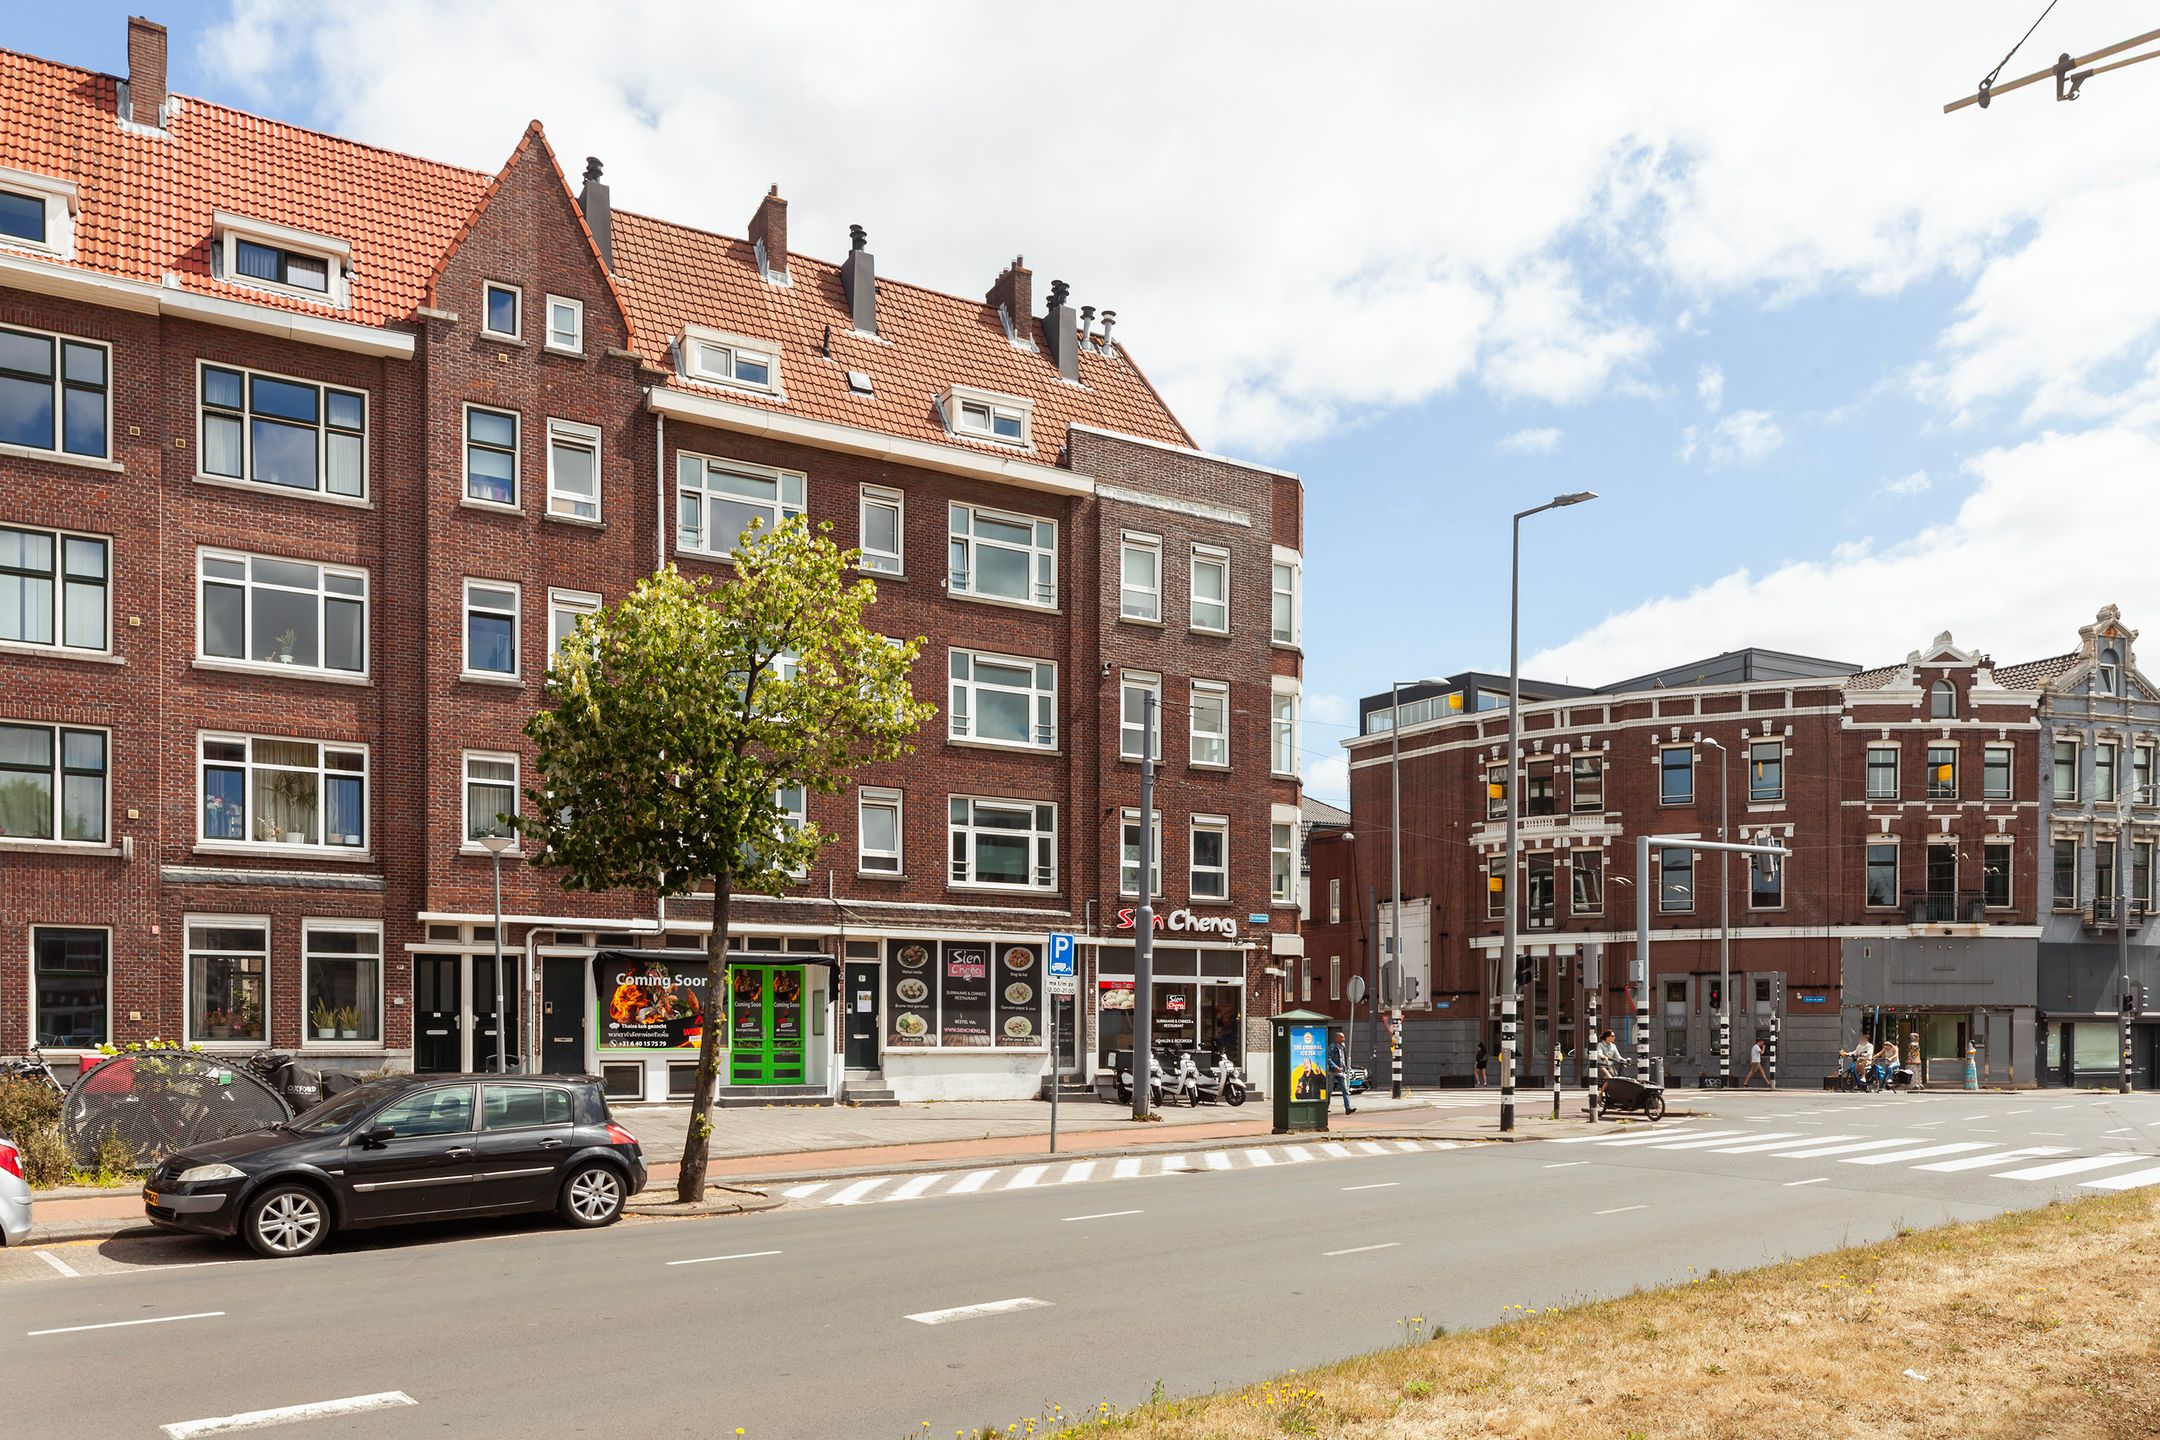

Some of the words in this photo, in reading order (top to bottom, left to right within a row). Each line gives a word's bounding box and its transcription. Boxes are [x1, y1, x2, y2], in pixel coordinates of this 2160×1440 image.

[1116, 908, 1164, 930] Sn
[1168, 908, 1237, 938] Cheng
[1055, 936, 1069, 958] P
[952, 950, 981, 964] Sien
[952, 964, 982, 977] Cheng
[615, 973, 671, 989] Coming
